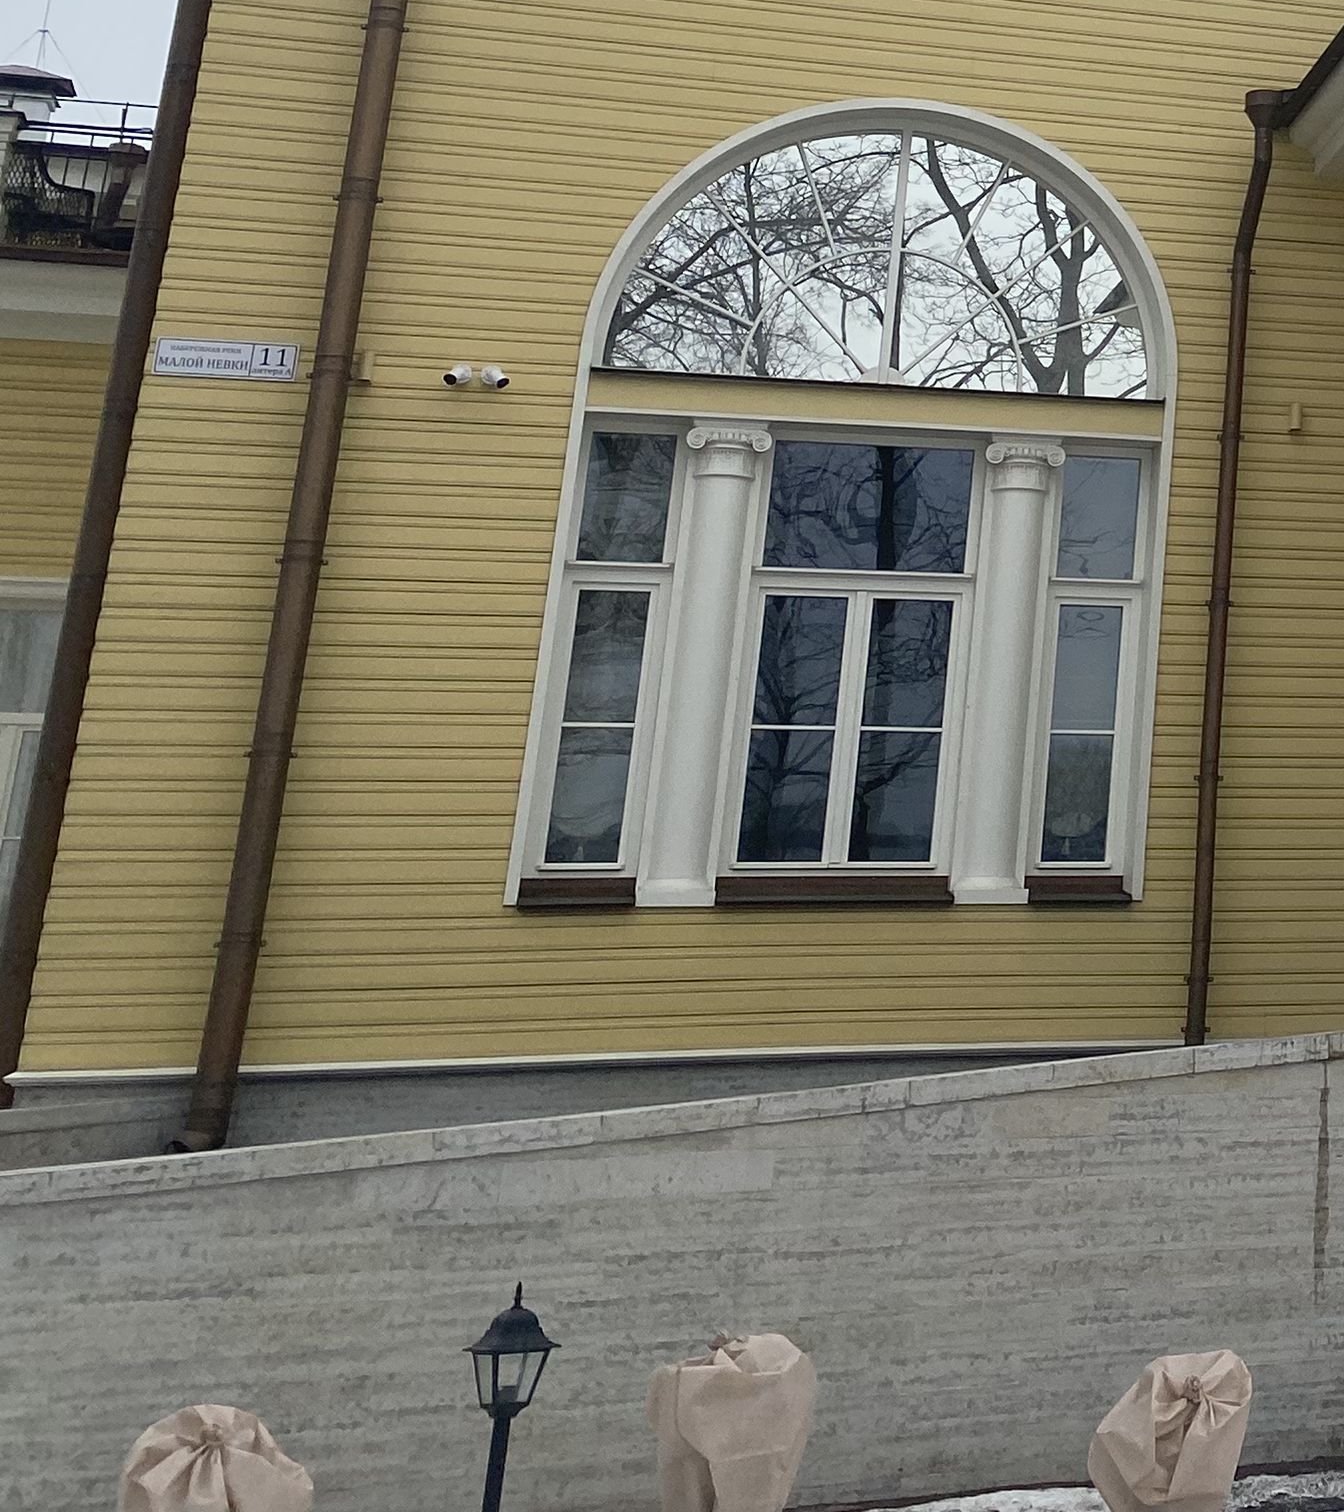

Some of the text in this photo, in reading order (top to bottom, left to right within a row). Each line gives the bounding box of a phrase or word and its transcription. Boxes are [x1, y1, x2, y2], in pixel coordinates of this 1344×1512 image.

[158, 355, 248, 371] МАЛОЙ НЕВКИ
[259, 347, 288, 367] 11
